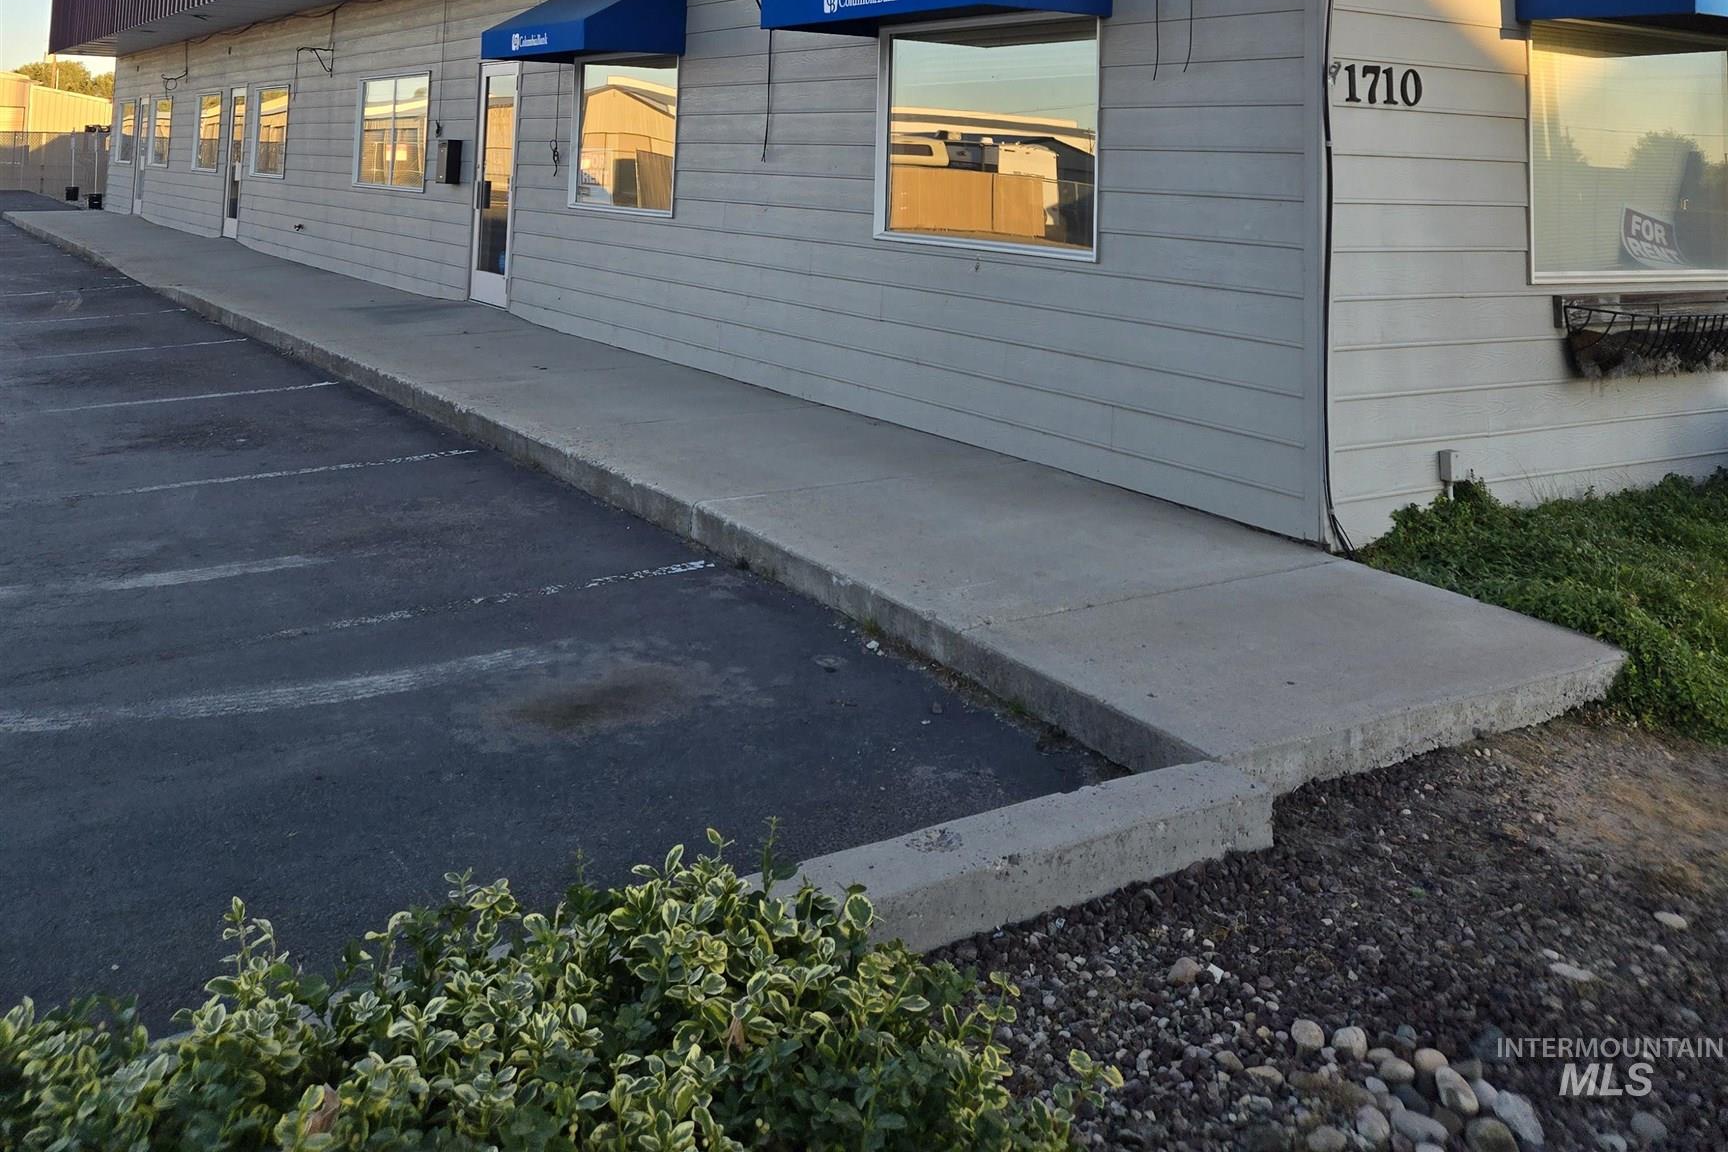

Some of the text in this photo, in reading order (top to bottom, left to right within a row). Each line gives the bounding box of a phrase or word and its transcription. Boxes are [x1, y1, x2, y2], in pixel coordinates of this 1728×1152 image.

[1344, 64, 1423, 107] 1710
[1631, 215, 1668, 246] FOR
[1627, 237, 1685, 265] RENT
